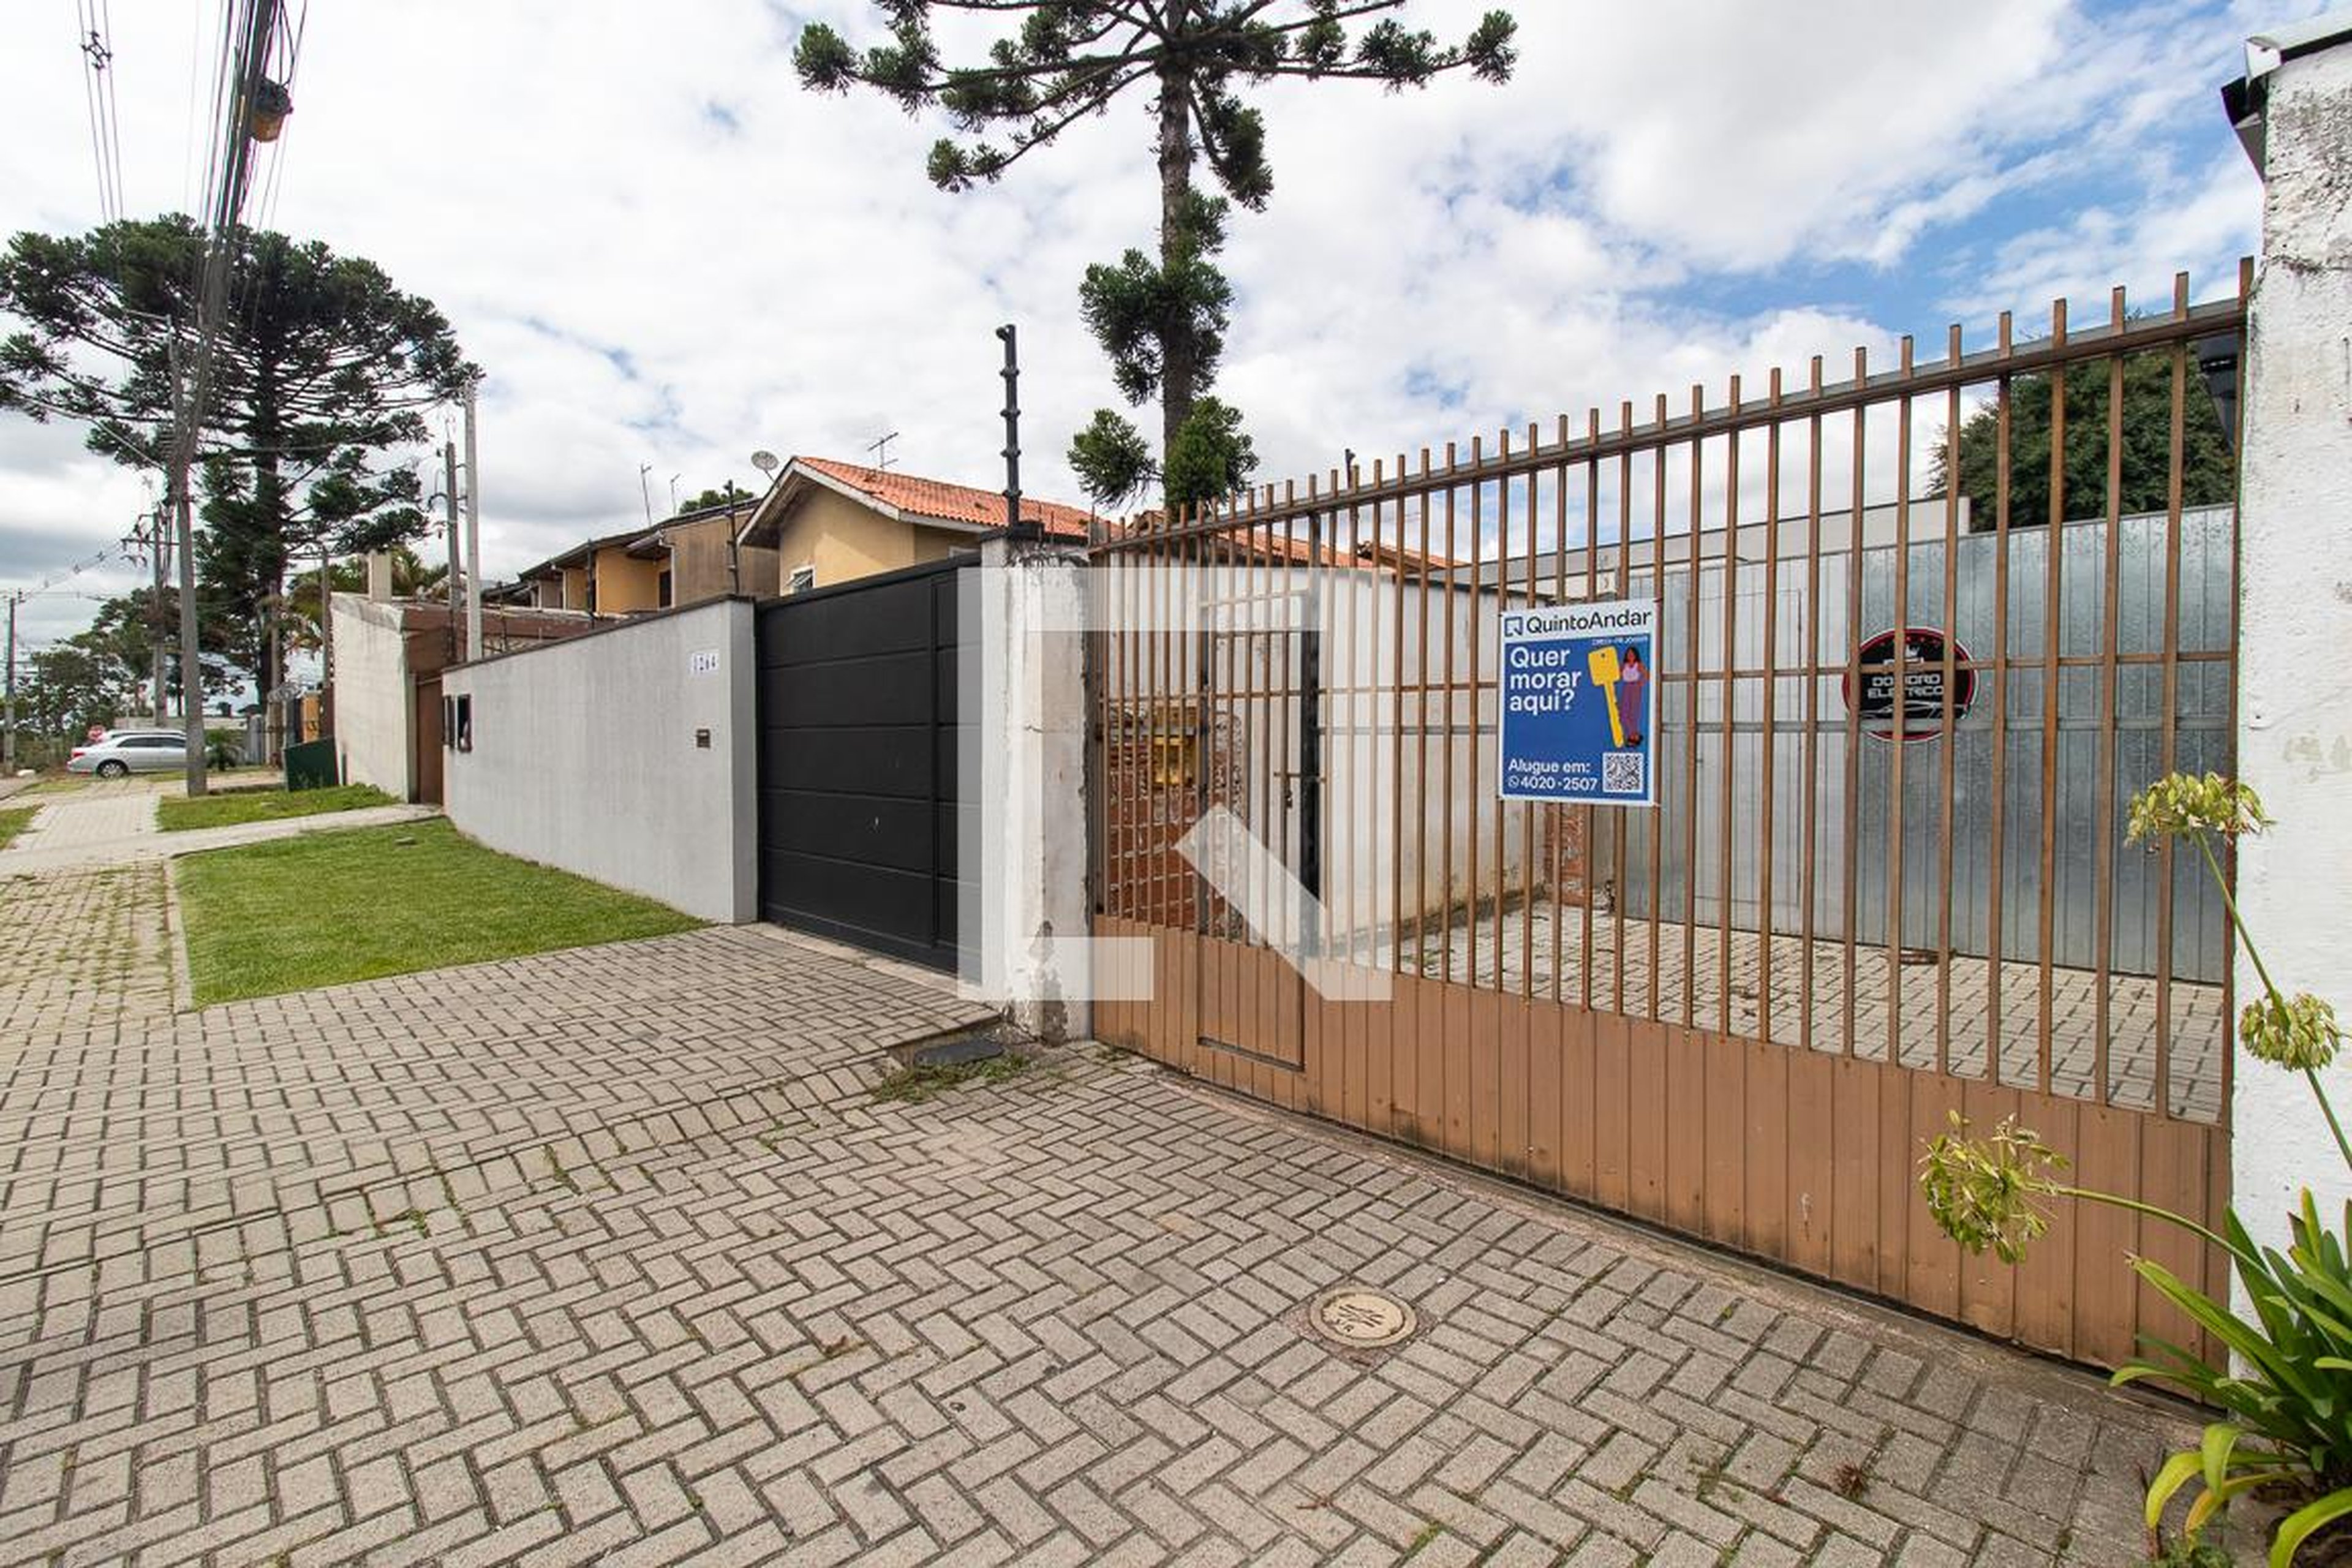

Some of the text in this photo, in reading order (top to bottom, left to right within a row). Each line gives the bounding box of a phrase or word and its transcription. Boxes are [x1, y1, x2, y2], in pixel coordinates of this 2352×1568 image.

[1526, 610, 1651, 634] QuintoAndar
[1510, 646, 1570, 668] Quer
[1509, 671, 1581, 690] morar
[1509, 688, 1575, 715] aqui?
[1508, 758, 1591, 775] Alugue em:
